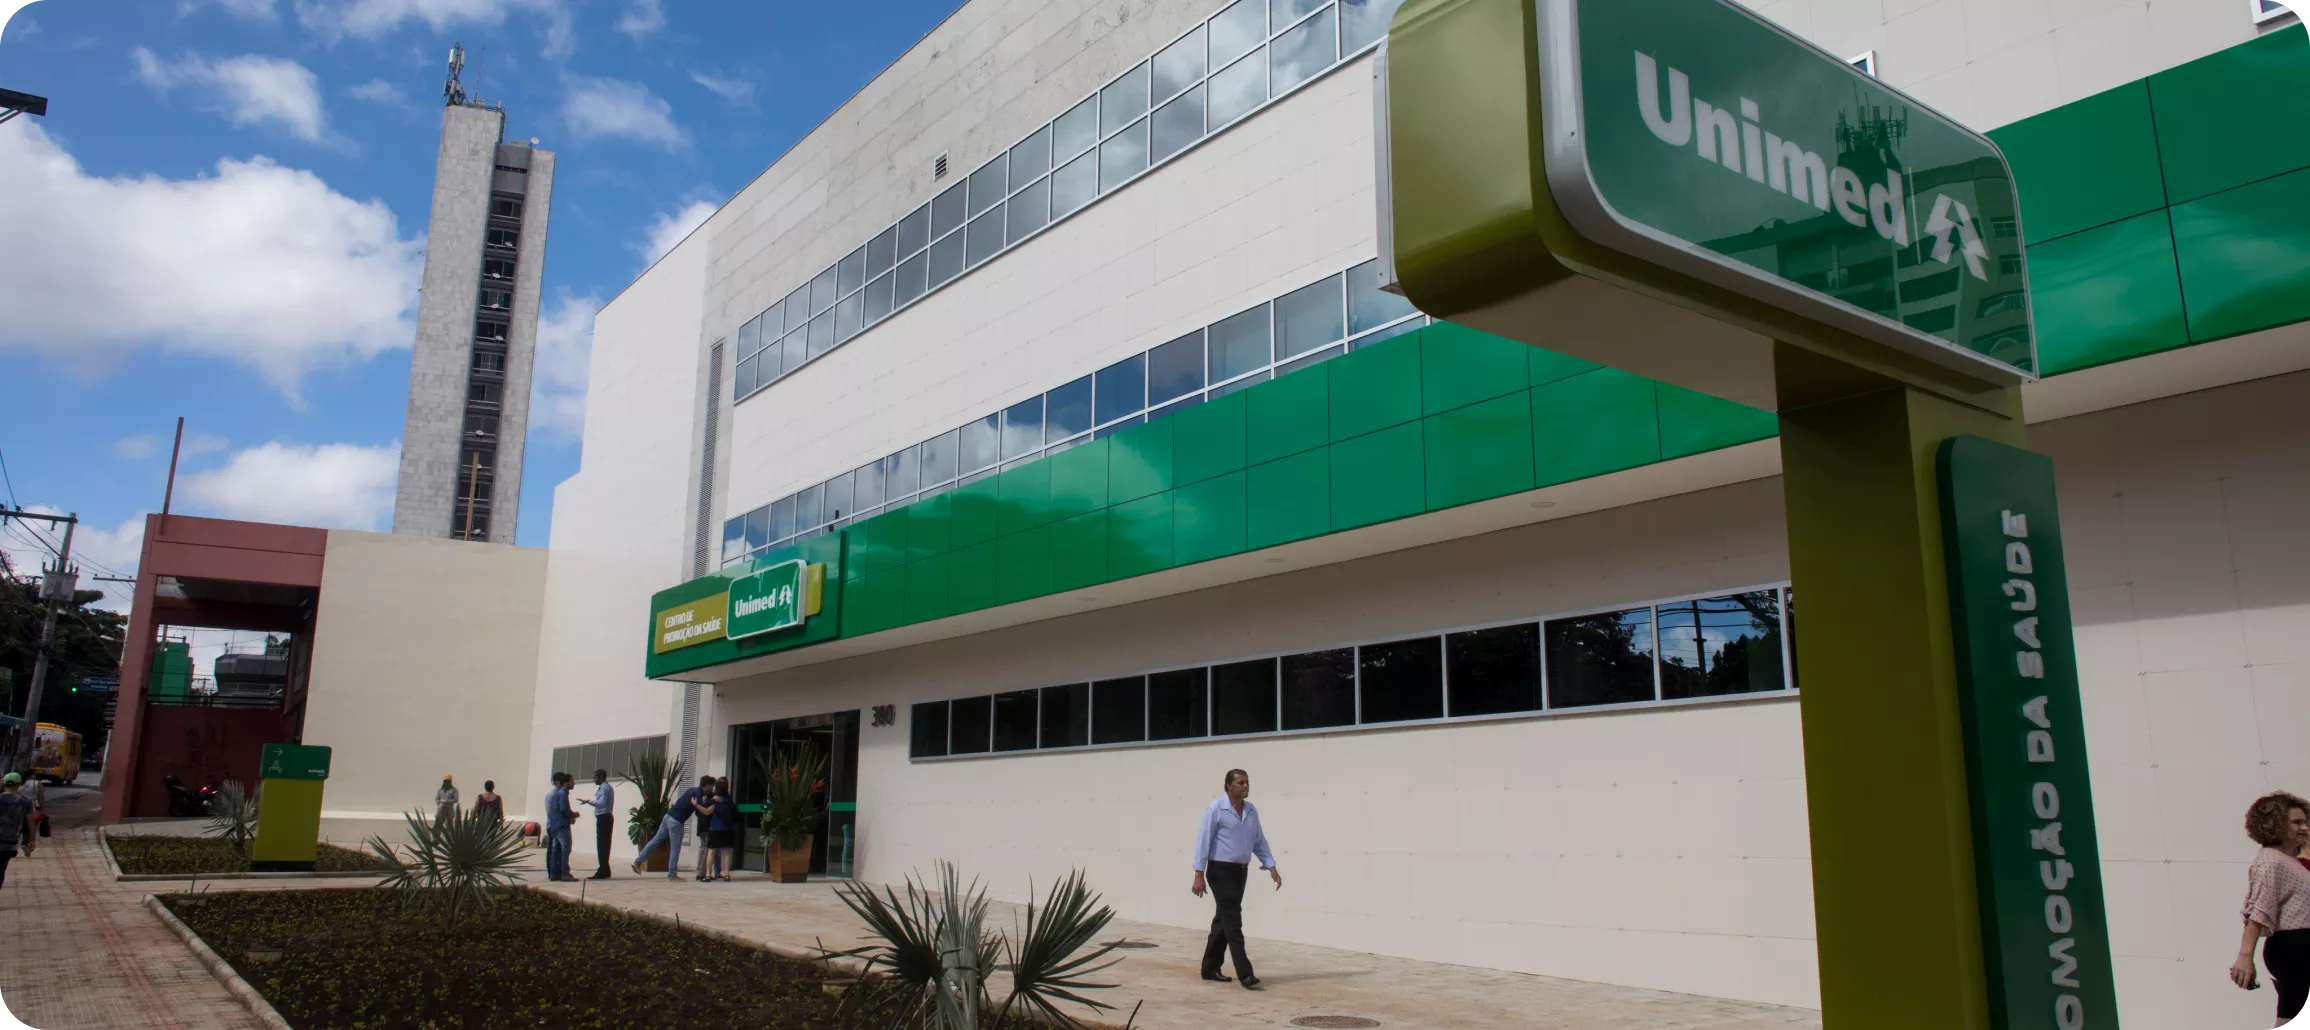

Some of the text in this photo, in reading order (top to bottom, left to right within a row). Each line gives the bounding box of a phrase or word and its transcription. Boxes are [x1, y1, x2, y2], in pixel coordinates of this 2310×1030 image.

[1634, 49, 1909, 249] Unimed
[734, 588, 777, 618] Unimed
[2001, 509, 2045, 680] SAÚDE
[663, 616, 722, 644] PROMOÇÃO DA SAÚDE
[664, 610, 695, 628] CENTRO DE
[2022, 696, 2056, 763] DA
